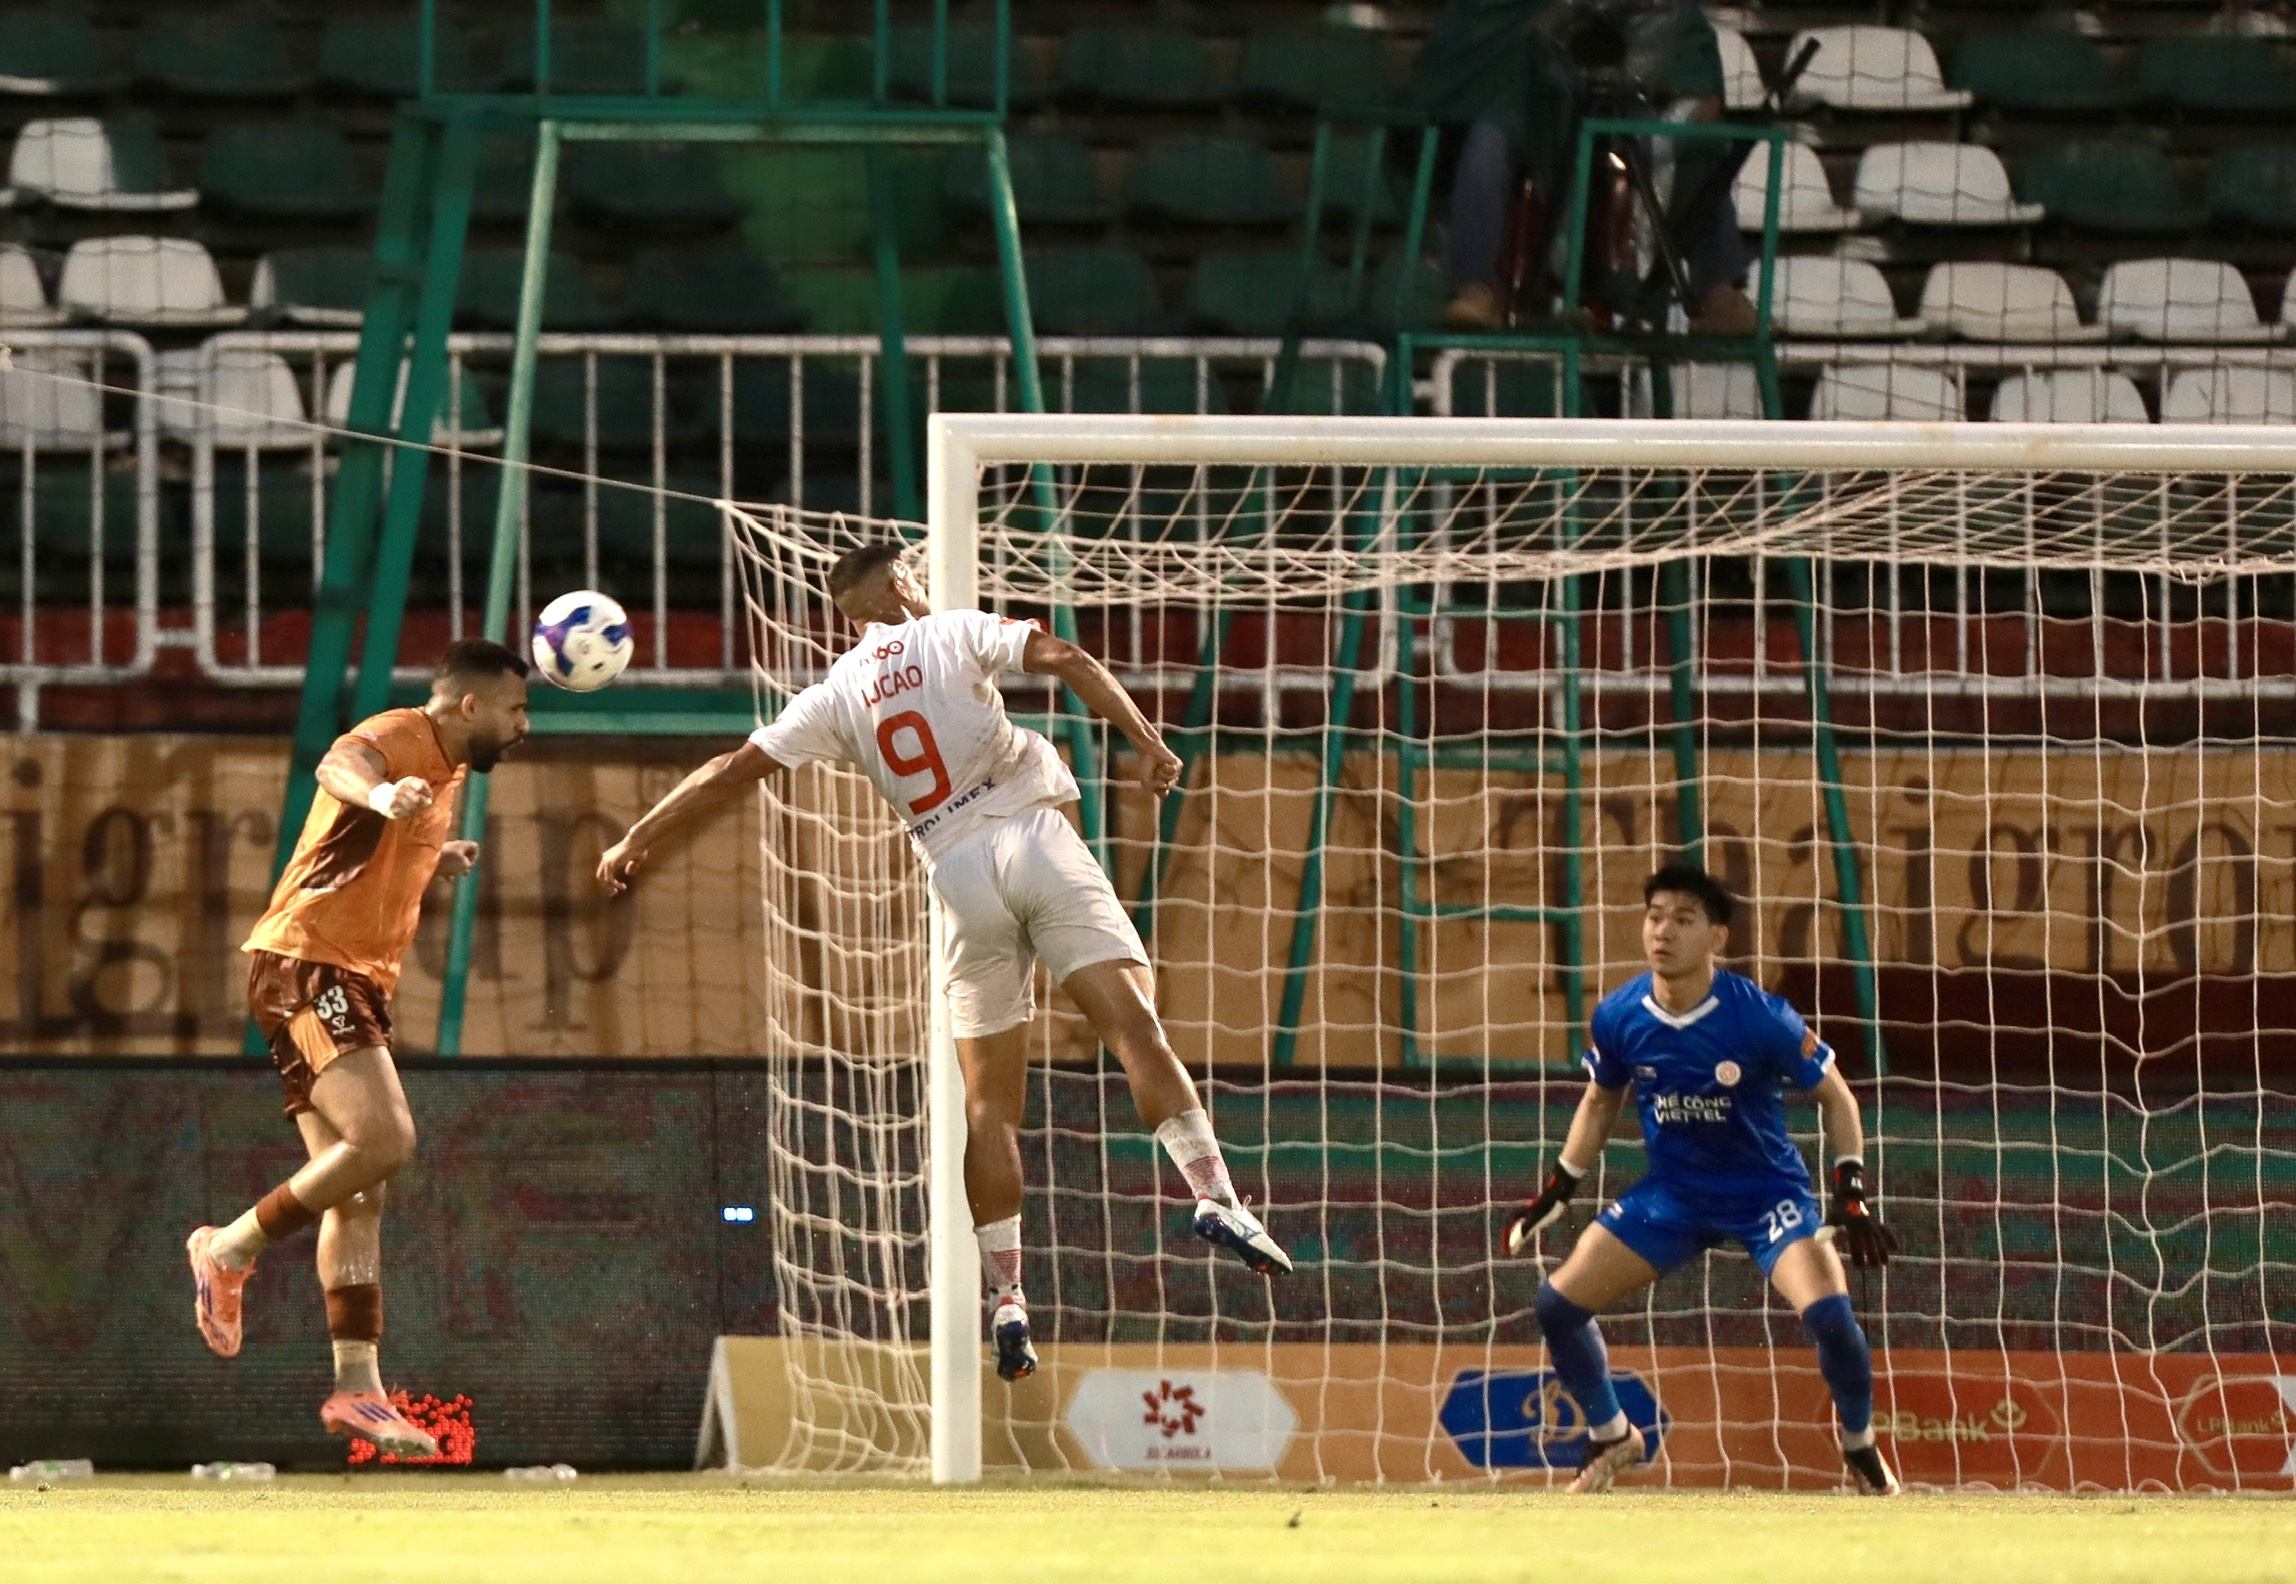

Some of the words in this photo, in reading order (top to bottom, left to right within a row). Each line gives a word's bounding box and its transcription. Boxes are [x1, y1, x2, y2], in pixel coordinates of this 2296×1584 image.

[876, 710, 952, 815] 9
[317, 985, 349, 1020] 33
[1759, 1199, 1803, 1244] 28
